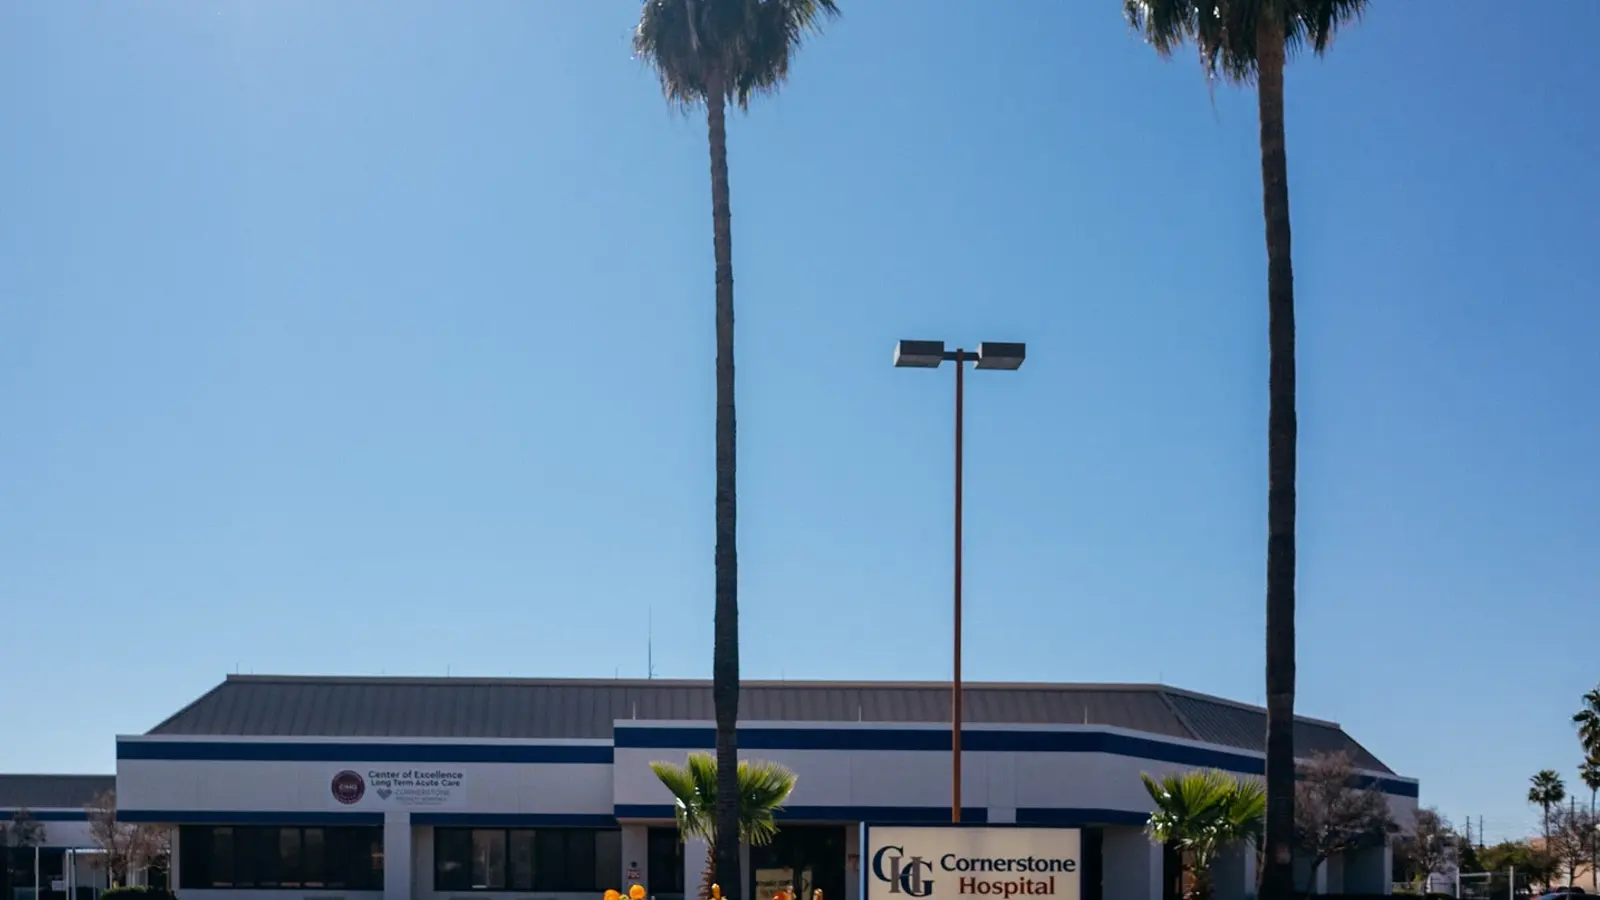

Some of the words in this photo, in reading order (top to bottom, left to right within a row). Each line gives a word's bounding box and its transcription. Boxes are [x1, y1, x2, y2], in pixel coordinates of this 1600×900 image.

[368, 770, 400, 779] Center
[402, 769, 412, 779] of
[414, 770, 463, 780] Excellence
[371, 779, 391, 788] Long
[394, 779, 414, 787] Term
[415, 779, 439, 787] Acute
[441, 779, 460, 787] Care
[940, 853, 1076, 873] Cornerstone
[959, 876, 1056, 899] Hospital
